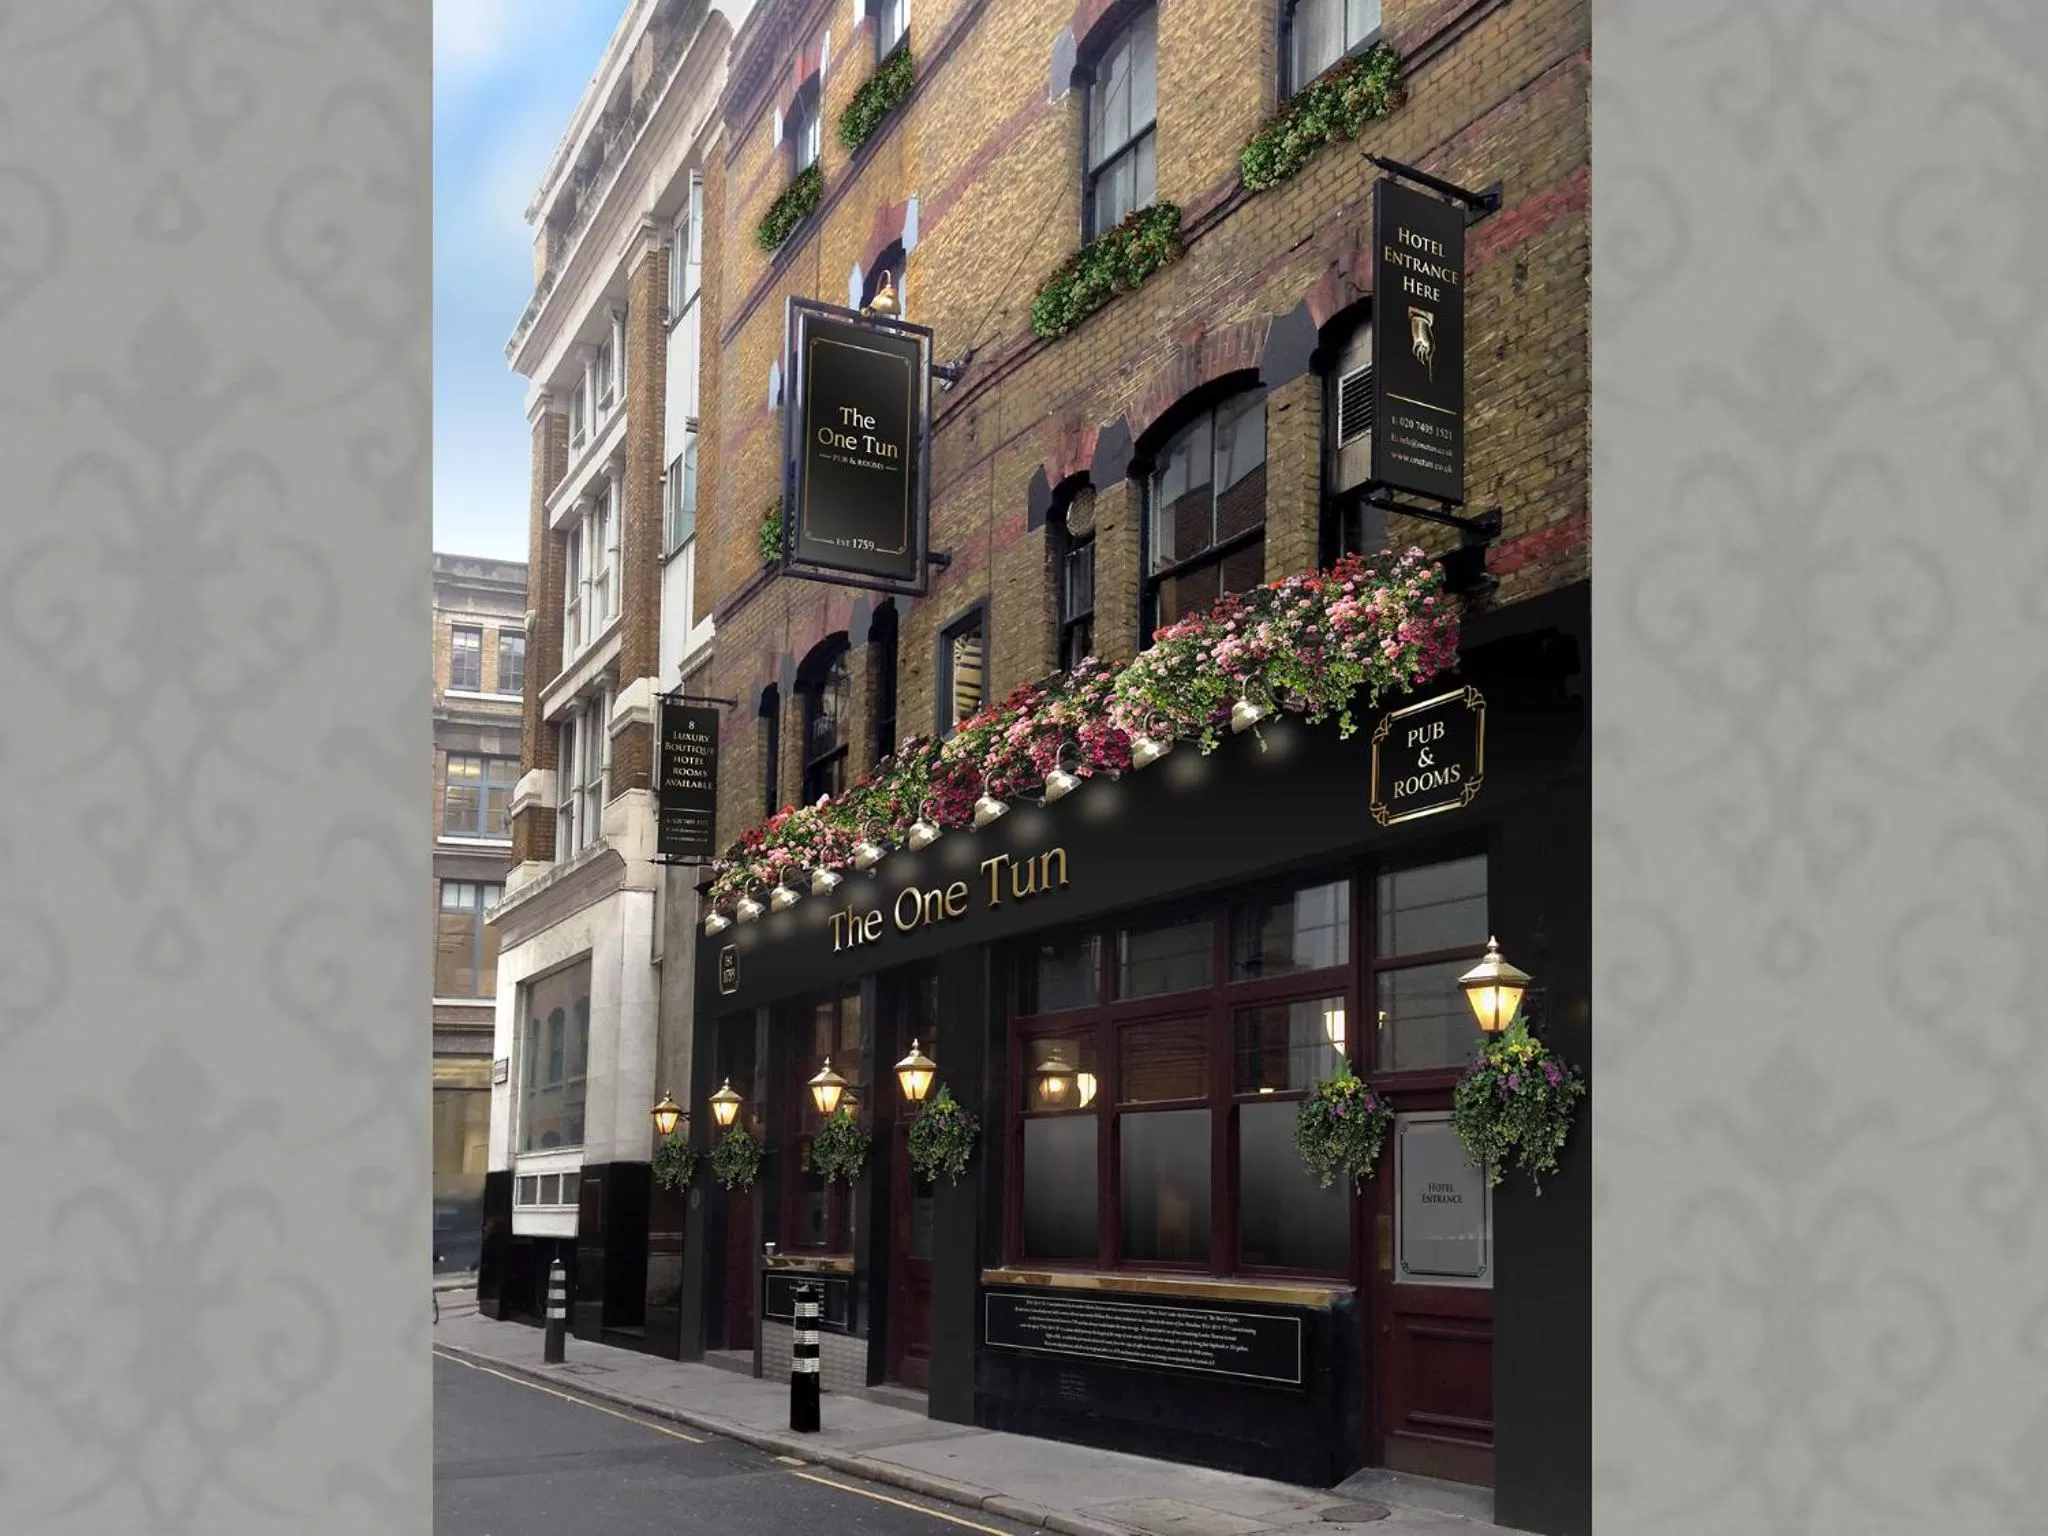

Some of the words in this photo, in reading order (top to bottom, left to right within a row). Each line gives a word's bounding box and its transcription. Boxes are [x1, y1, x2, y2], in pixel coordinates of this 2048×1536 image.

[1399, 227, 1446, 258] HOTEL
[1383, 245, 1459, 285] ENTRANCE
[1403, 275, 1441, 302] HERE
[839, 406, 876, 430] The
[818, 427, 857, 450] One
[863, 435, 899, 459] Tun
[853, 538, 875, 551] 1759
[672, 731, 711, 743] LUXURY
[688, 720, 696, 730] 8
[1408, 721, 1445, 748] PUB
[673, 755, 704, 766] HOTEL
[1418, 746, 1436, 768] &
[672, 767, 708, 777] ROOMS
[1394, 764, 1461, 799] ROOMS
[828, 904, 883, 953] The
[894, 880, 970, 932] One
[980, 847, 1070, 907] Tun
